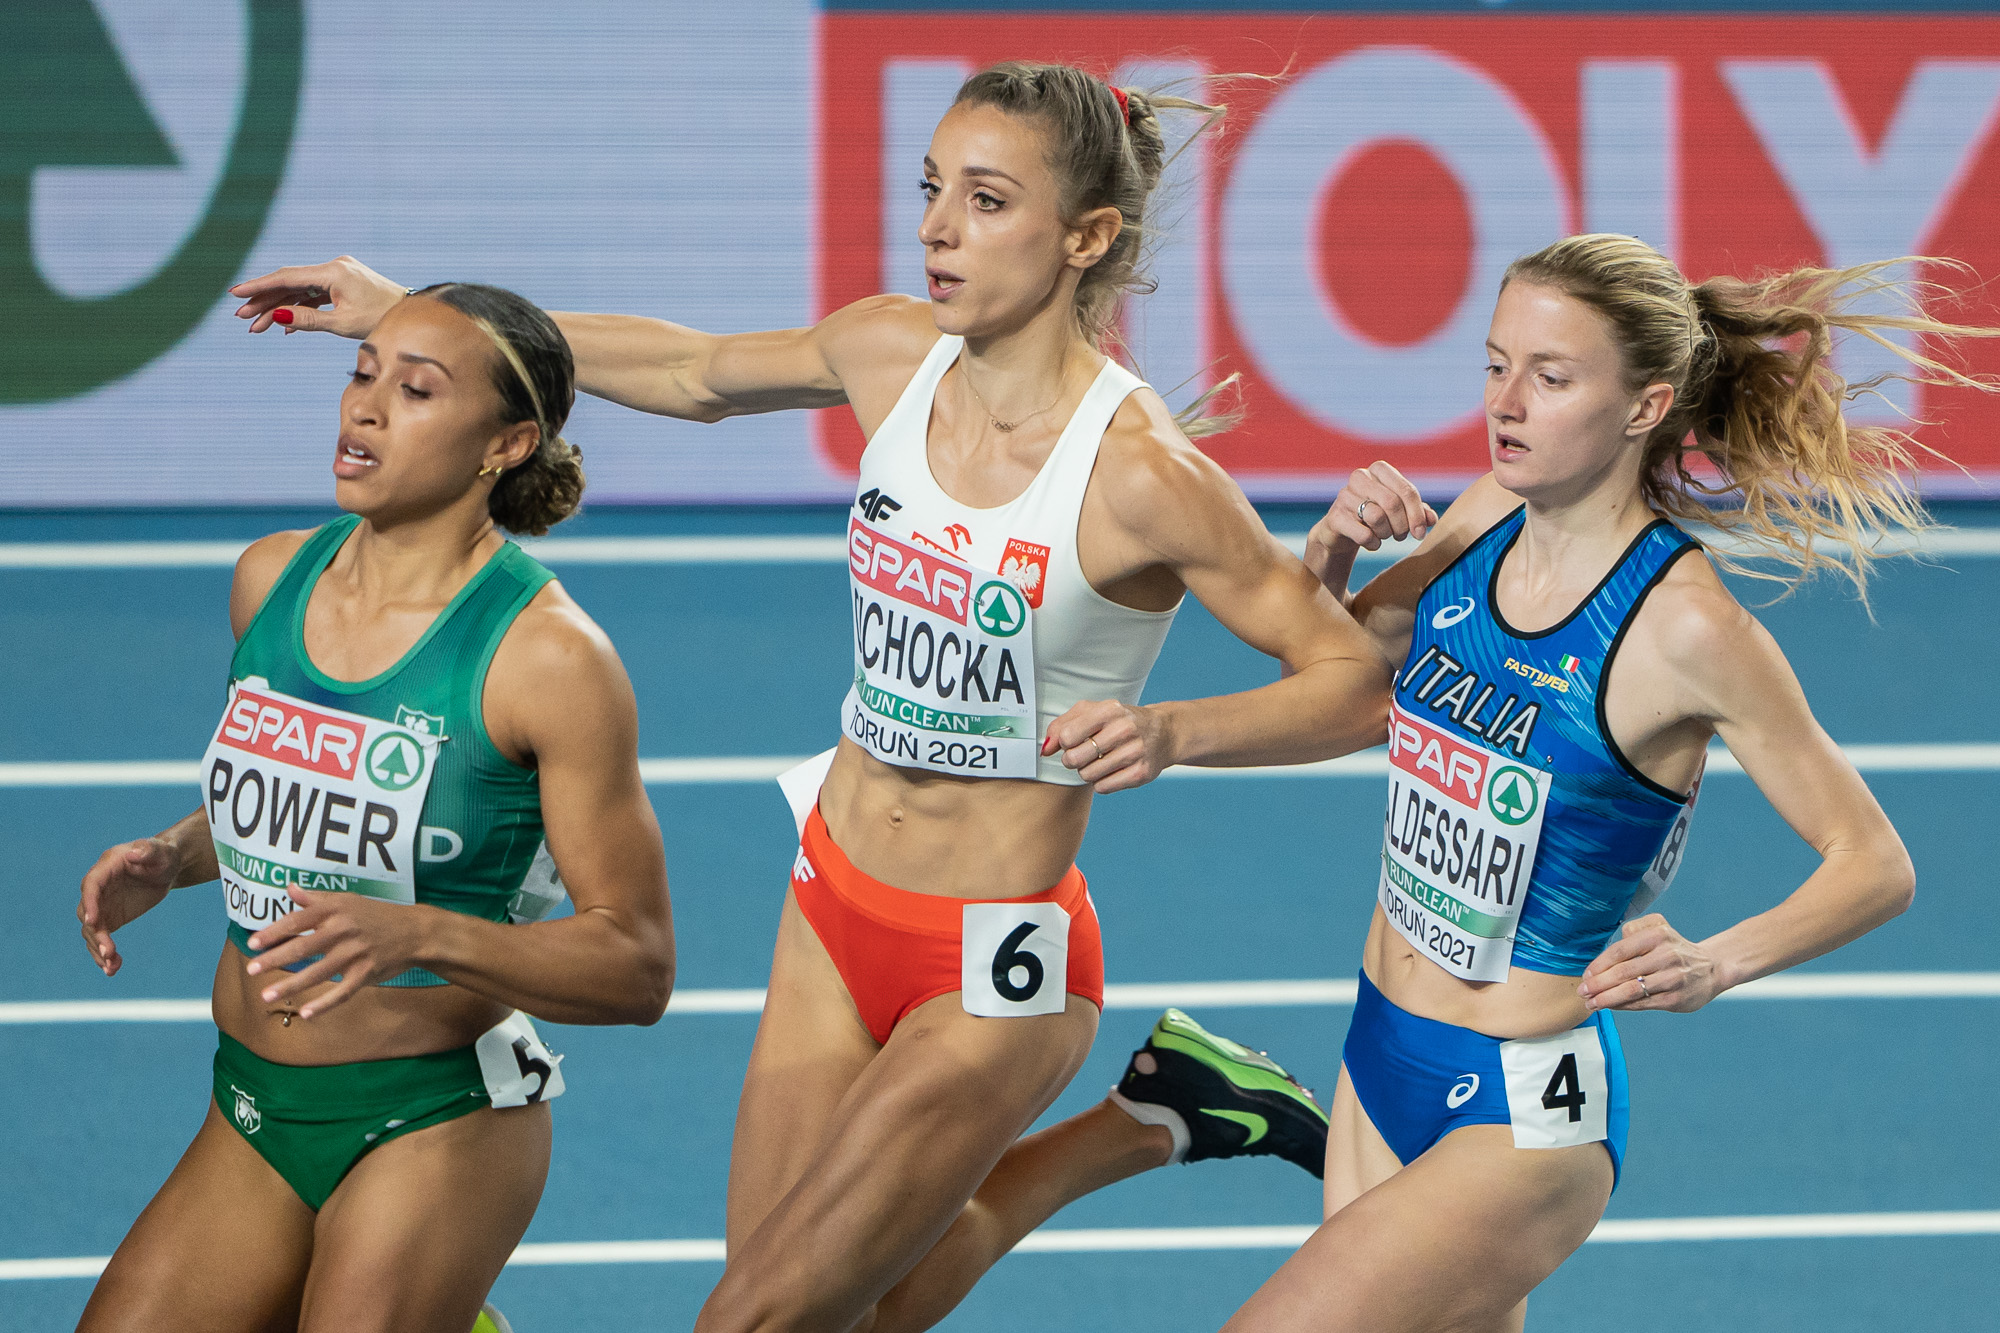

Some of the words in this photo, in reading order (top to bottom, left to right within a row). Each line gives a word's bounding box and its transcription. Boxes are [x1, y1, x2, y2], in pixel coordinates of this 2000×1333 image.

[851, 529, 967, 617] SPAR
[1009, 540, 1046, 558] POLSKA
[1400, 643, 1541, 758] ITALIA
[1503, 657, 1570, 693] FASTWEB
[225, 698, 357, 771] SPAR
[850, 704, 918, 760] TORUŃ
[928, 740, 998, 770] 2021
[209, 757, 398, 873] POWER
[236, 852, 267, 882] RUN
[1390, 861, 1413, 893] RUN
[1384, 878, 1426, 943] TORUŃ
[1428, 924, 1476, 970] 2021
[992, 920, 1045, 1003] 6
[511, 1036, 552, 1105] 5
[1541, 1053, 1586, 1124] 4
